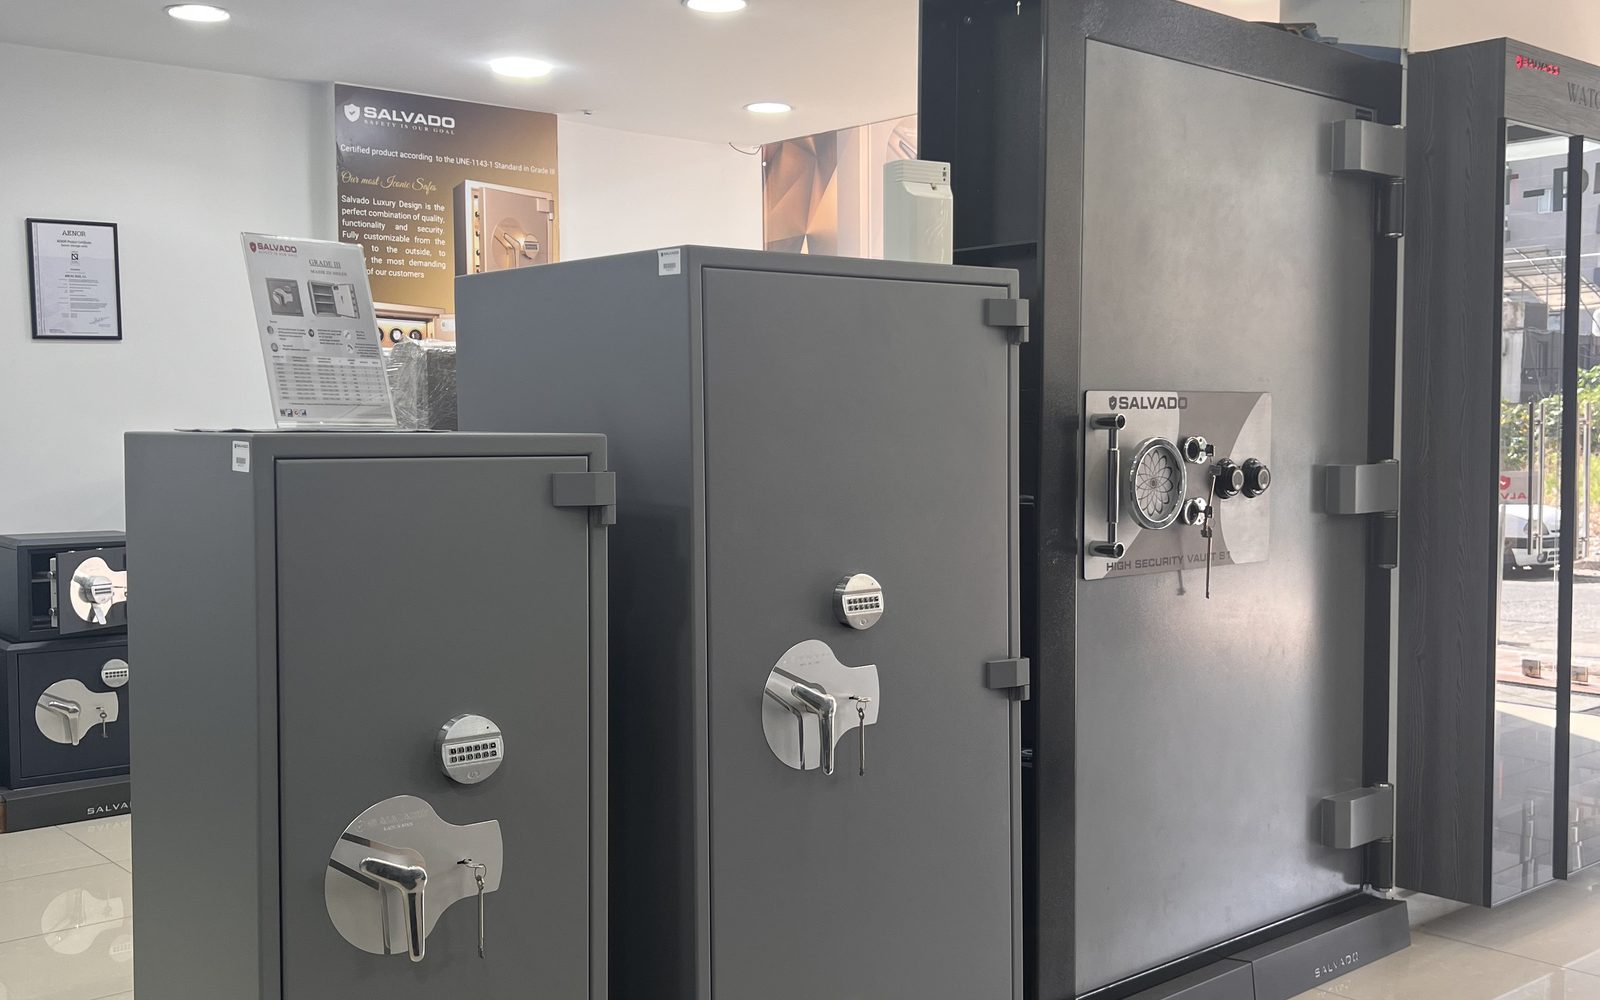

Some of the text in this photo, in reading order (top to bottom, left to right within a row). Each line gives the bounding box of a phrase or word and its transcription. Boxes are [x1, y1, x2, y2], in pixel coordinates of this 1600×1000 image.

[363, 106, 455, 128] SALVADO
[340, 143, 370, 154] Certified
[371, 149, 398, 158] product
[400, 151, 433, 163] according
[436, 155, 443, 163] to
[444, 156, 455, 164] the
[455, 157, 493, 168] UNE-1143-1
[494, 161, 522, 171] Standard
[530, 165, 548, 174] Grade
[341, 170, 359, 184] Our
[361, 176, 380, 185] most
[380, 175, 410, 189] Iconic
[341, 195, 370, 205] Salvado
[372, 198, 396, 208] Luxury
[399, 200, 422, 210] Design
[434, 204, 445, 212] the
[341, 207, 445, 224] perfect combination of quality,
[342, 219, 386, 231] functionality
[395, 223, 408, 231] and
[342, 230, 446, 246] Fully customizable from the
[257, 242, 298, 253] SALVADO
[386, 246, 398, 254] the
[405, 247, 432, 257] outside,
[371, 256, 383, 264] the
[386, 258, 405, 266] most
[408, 259, 447, 270] demanding
[367, 267, 374, 275] of
[388, 270, 425, 278] customers
[1118, 396, 1188, 410] SALVADO
[1106, 560, 1132, 571] HIGH
[1134, 555, 1184, 569] SECURITY
[1187, 552, 1216, 563] VAUT
[87, 802, 131, 815] SALVA
[1314, 951, 1359, 978] SALVADO
